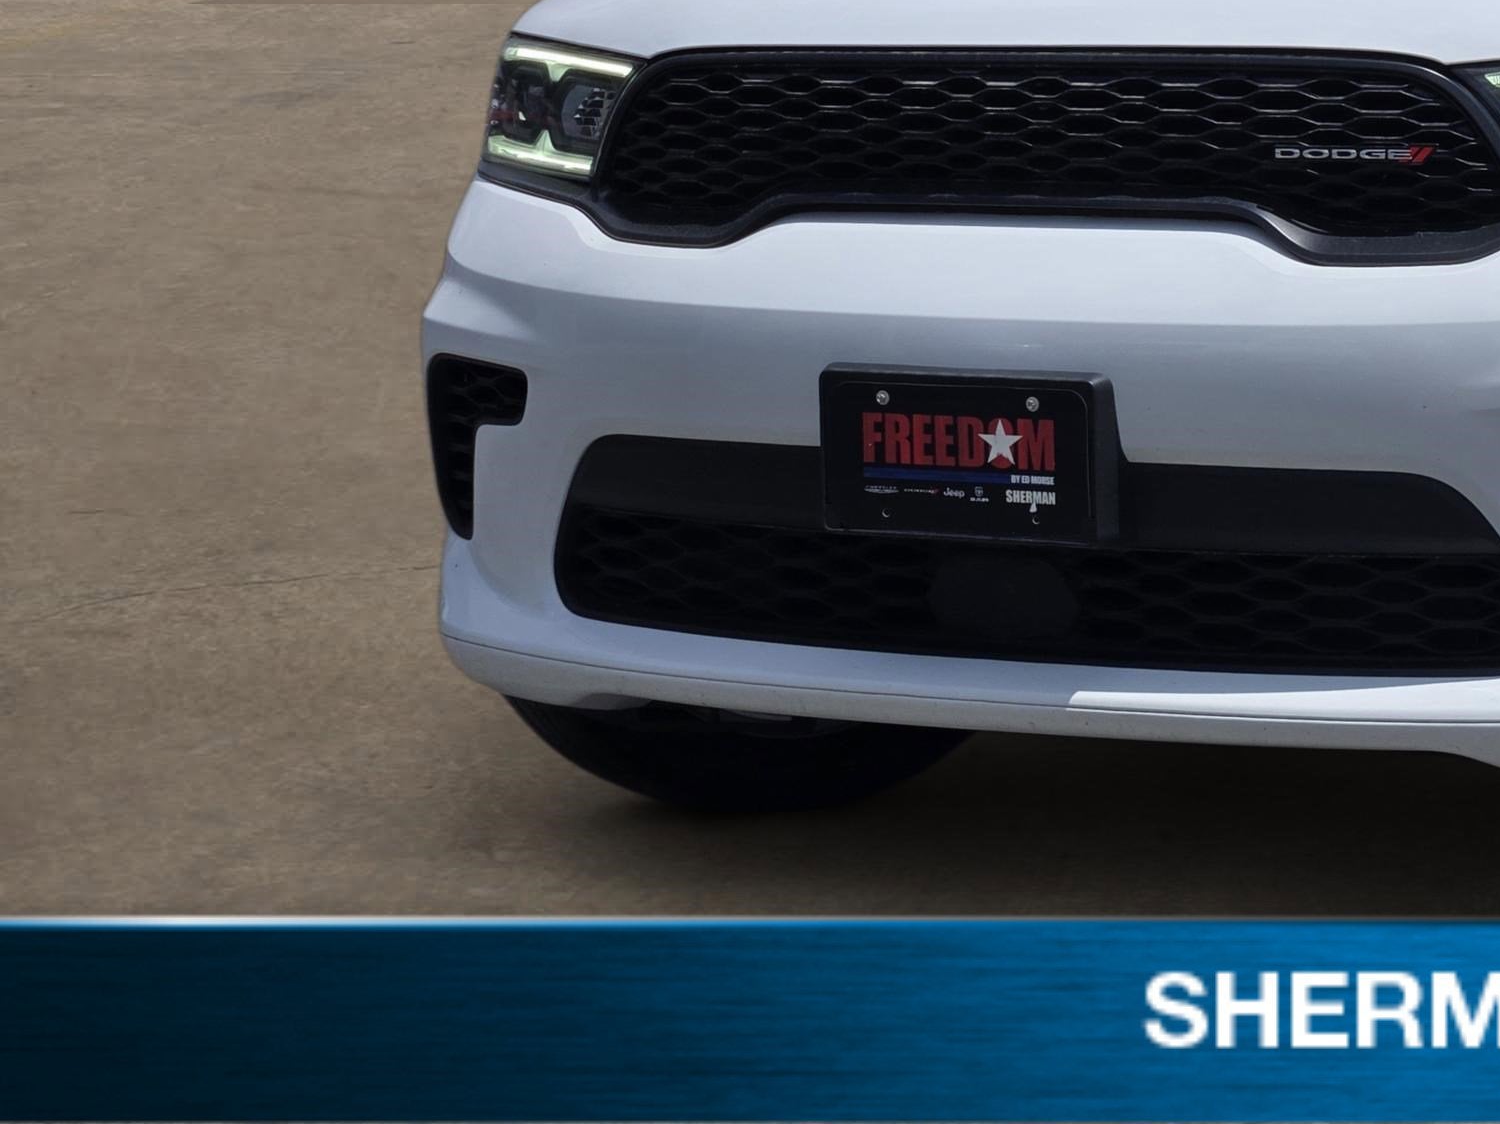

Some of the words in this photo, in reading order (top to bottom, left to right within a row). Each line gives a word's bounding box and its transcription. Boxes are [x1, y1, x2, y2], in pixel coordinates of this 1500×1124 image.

[1274, 147, 1413, 160] DODGE
[861, 412, 1056, 471] FREEDOM
[943, 487, 965, 499] Jeep
[1005, 489, 1056, 505] SHERMAN
